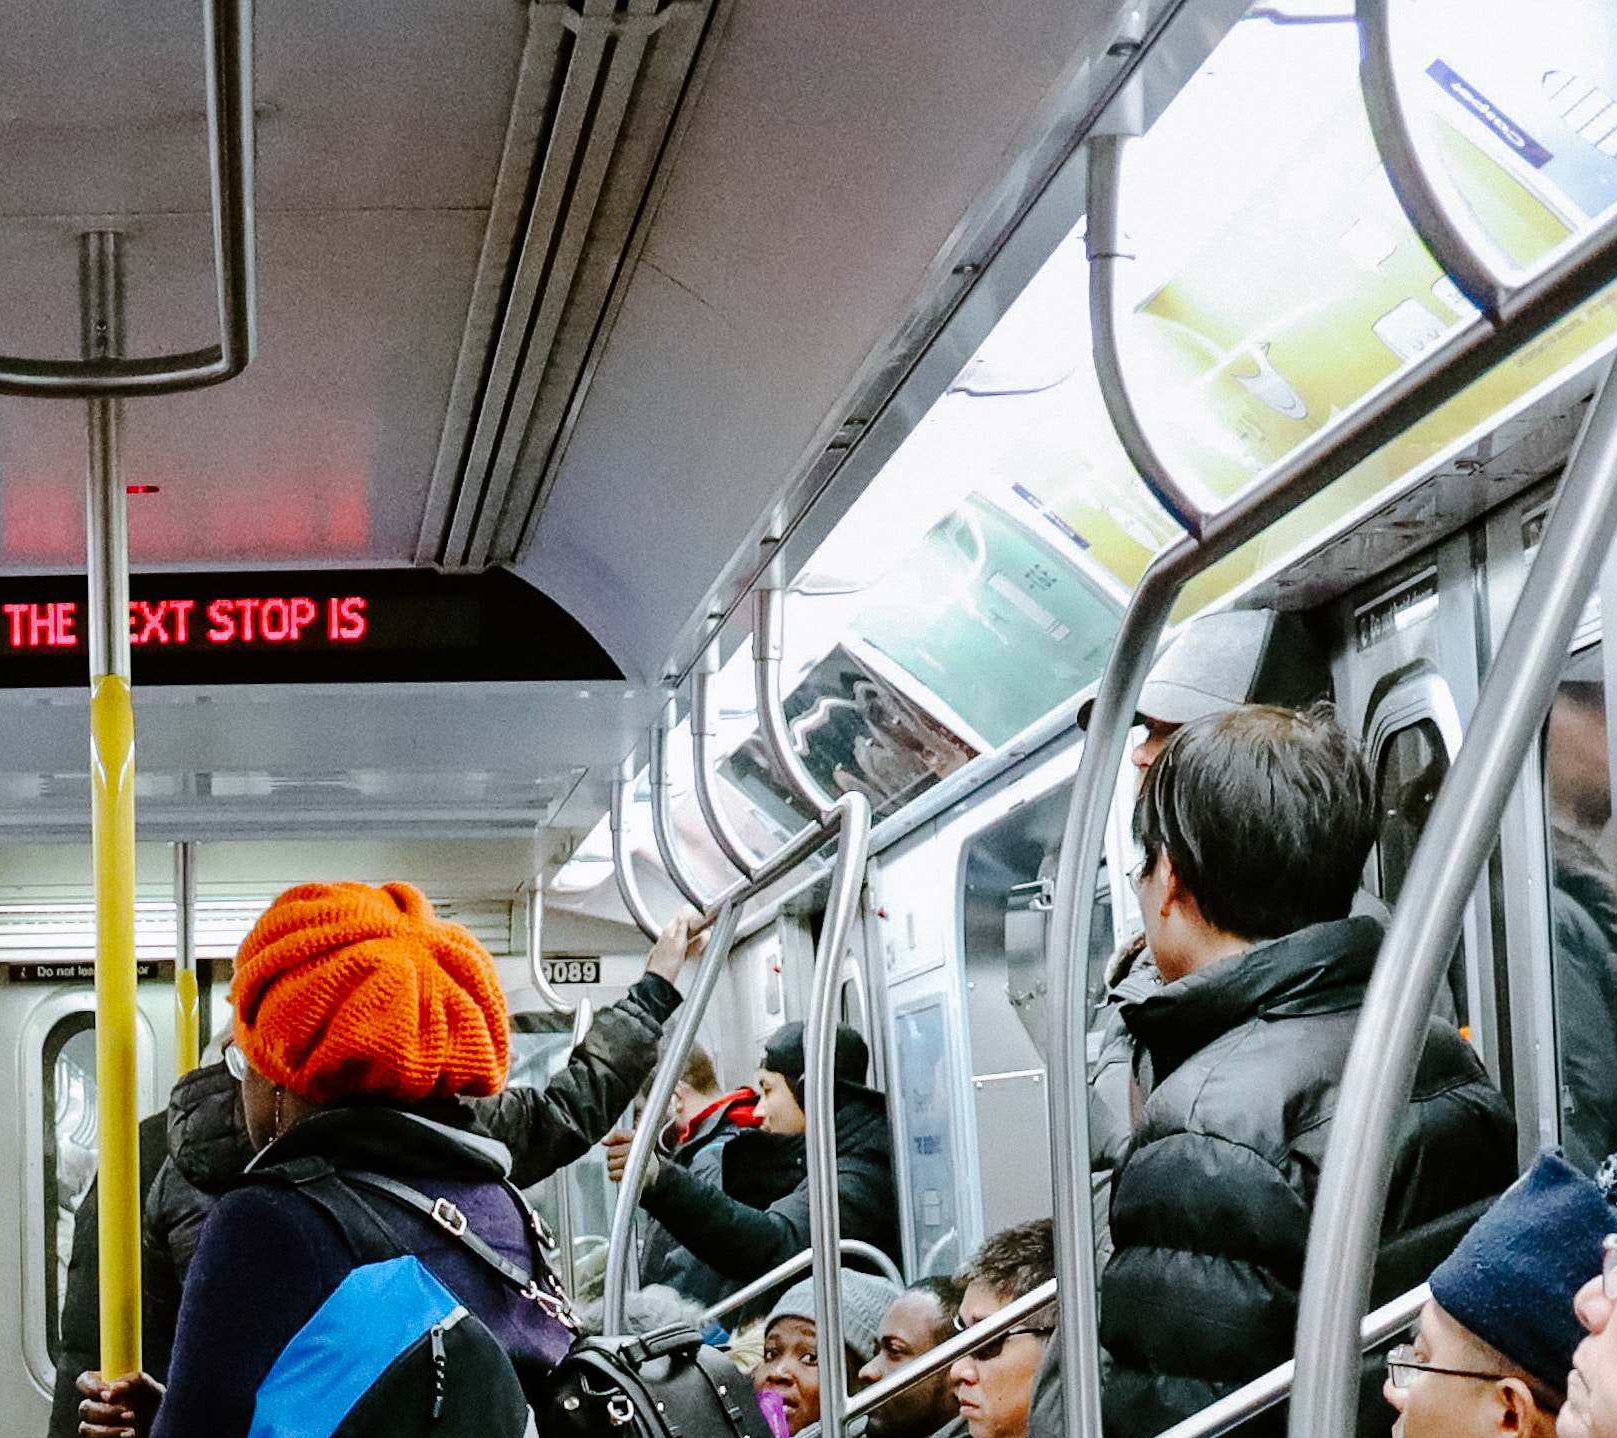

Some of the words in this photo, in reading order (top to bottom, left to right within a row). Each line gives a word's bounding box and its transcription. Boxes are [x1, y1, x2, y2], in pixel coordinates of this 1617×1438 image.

[3, 603, 77, 647] THE
[129, 600, 192, 645] EXT
[207, 597, 316, 643] STOP
[328, 596, 367, 640] IS
[37, 966, 54, 977] Do
[56, 966, 75, 977] not
[78, 965, 95, 977] lea
